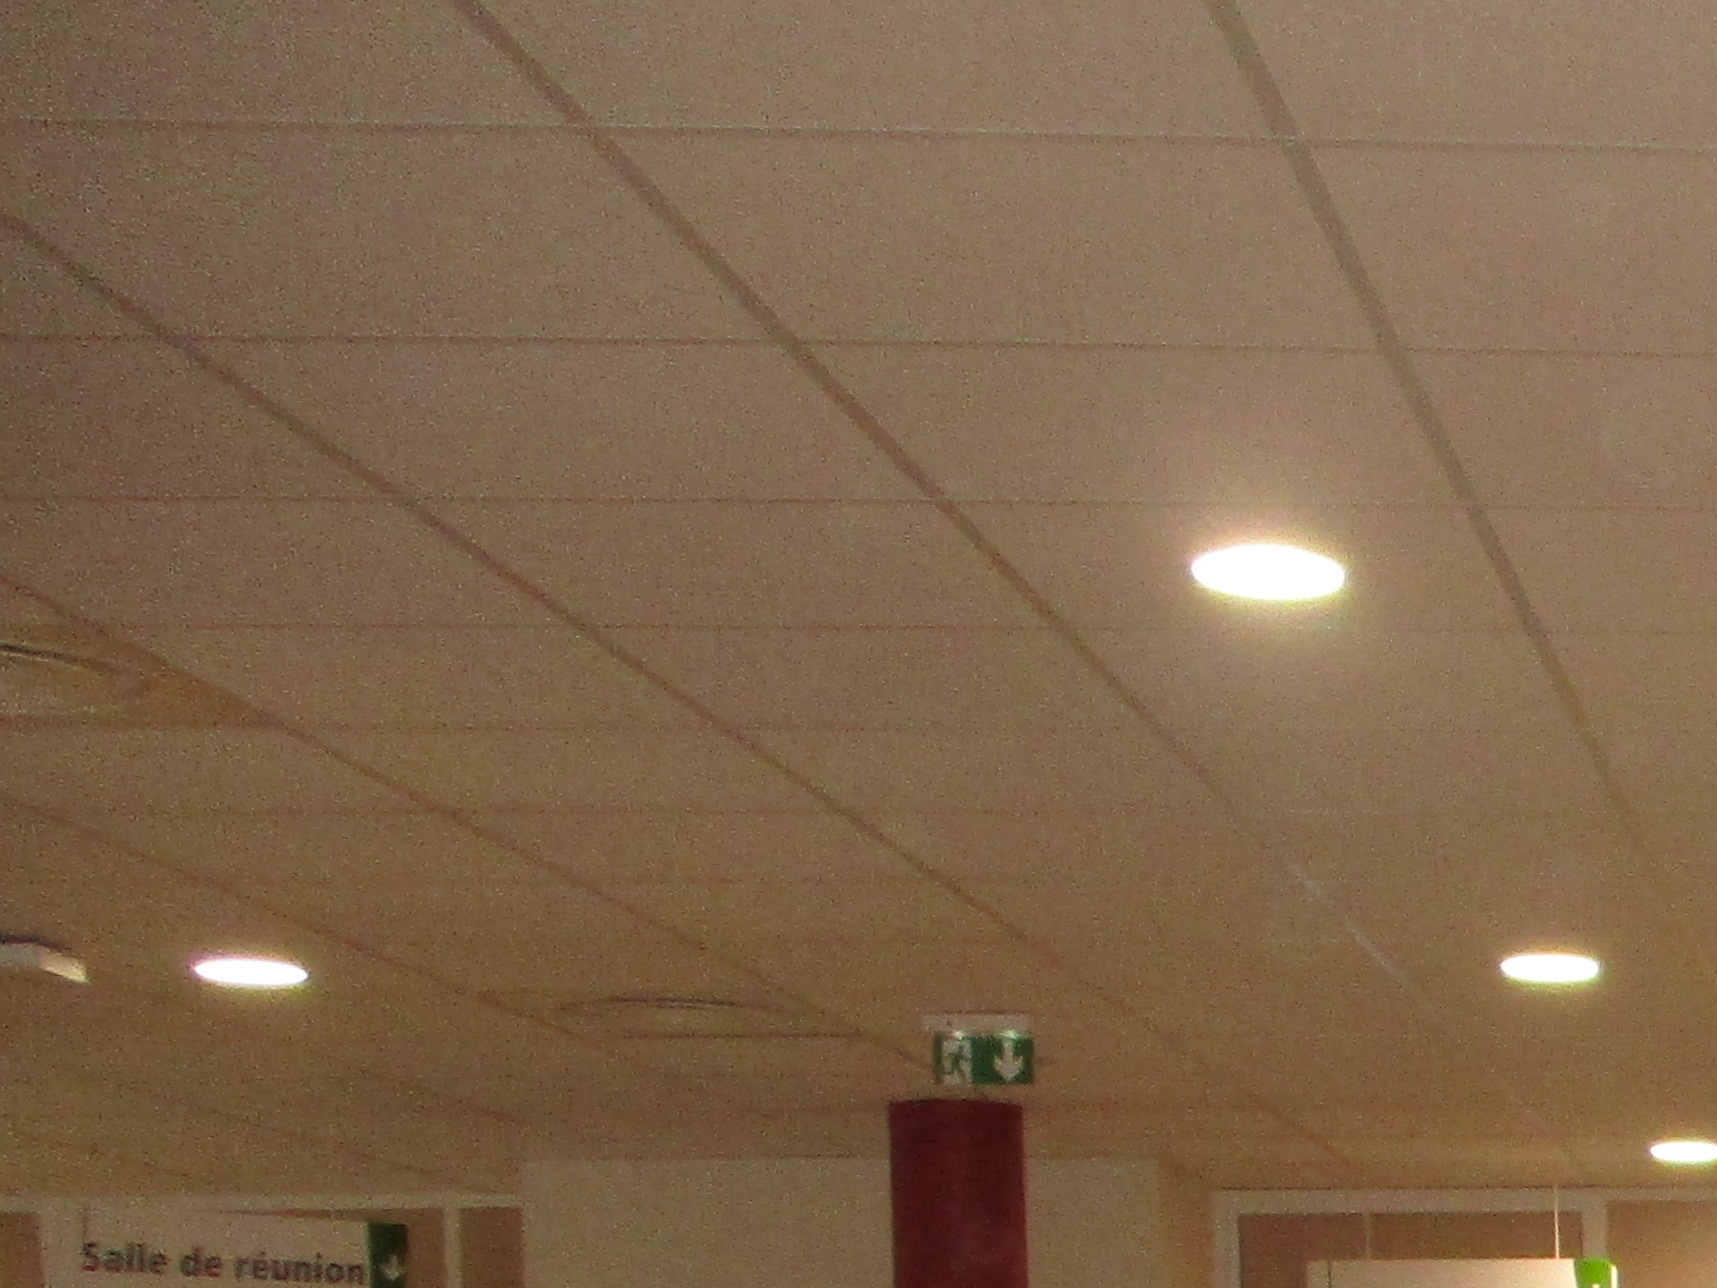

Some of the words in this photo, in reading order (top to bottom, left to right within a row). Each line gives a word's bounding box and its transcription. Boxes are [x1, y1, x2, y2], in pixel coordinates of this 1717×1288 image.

[81, 1242, 168, 1275] Salle
[180, 1246, 224, 1279] de
[234, 1251, 365, 1285] réunion
